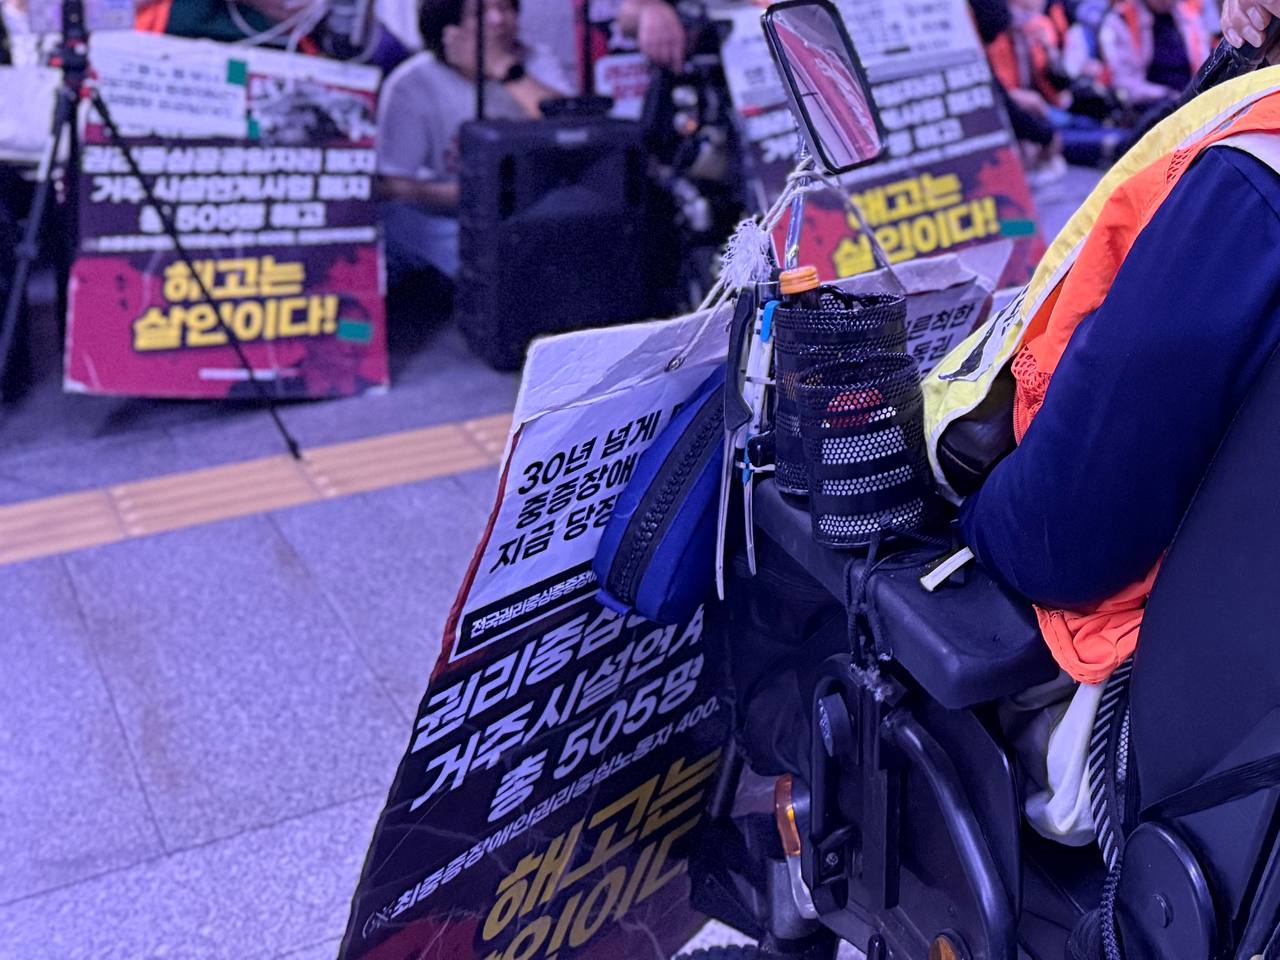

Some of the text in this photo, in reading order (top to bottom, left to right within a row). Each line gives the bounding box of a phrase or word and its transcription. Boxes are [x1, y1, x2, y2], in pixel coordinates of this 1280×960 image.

[848, 172, 963, 232] 해고는
[163, 256, 304, 302] 해고는
[133, 296, 339, 351] 살인이다!
[905, 301, 976, 344] 른척한
[518, 409, 662, 495] 30년 넘게
[489, 521, 556, 573] 지금
[411, 608, 652, 754] 권리중심
[487, 652, 705, 823] 총 505명
[675, 696, 722, 735] 400
[482, 746, 722, 941] 해고는
[482, 814, 702, 960] 인이
